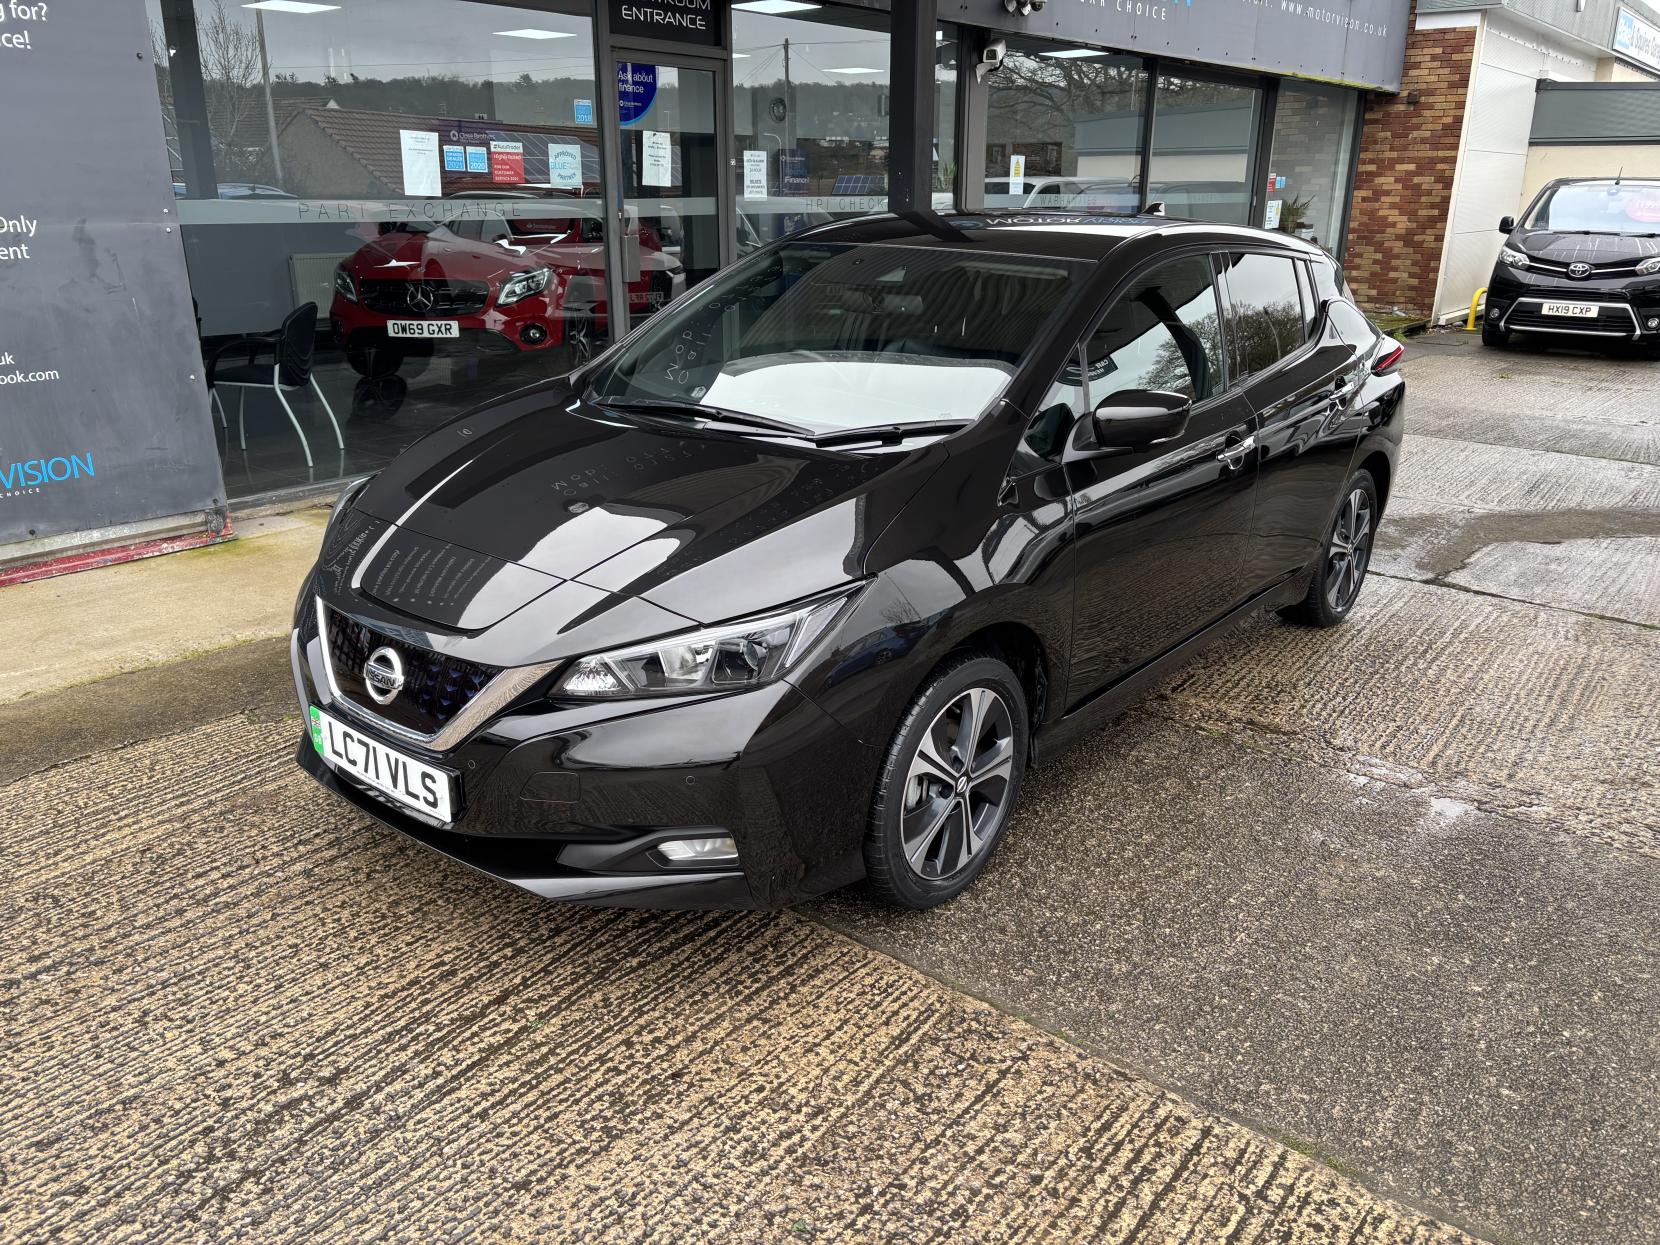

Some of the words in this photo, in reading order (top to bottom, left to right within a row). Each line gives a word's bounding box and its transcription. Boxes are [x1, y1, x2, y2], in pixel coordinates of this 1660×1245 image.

[9, 0, 47, 21] for?
[622, 5, 706, 30] ENTRANCE
[1117, 0, 1166, 20] CHOICE
[0, 30, 32, 50] ce!
[633, 71, 653, 83] about
[298, 202, 367, 219] PART
[387, 202, 521, 218] EXCHANGE
[1548, 304, 1570, 314] HX19
[1571, 306, 1592, 315] CXP
[427, 323, 453, 335] GXR
[0, 452, 95, 489] VISION
[365, 668, 396, 687] NISSAN
[328, 720, 380, 781] LC71
[385, 752, 439, 809] VLS
